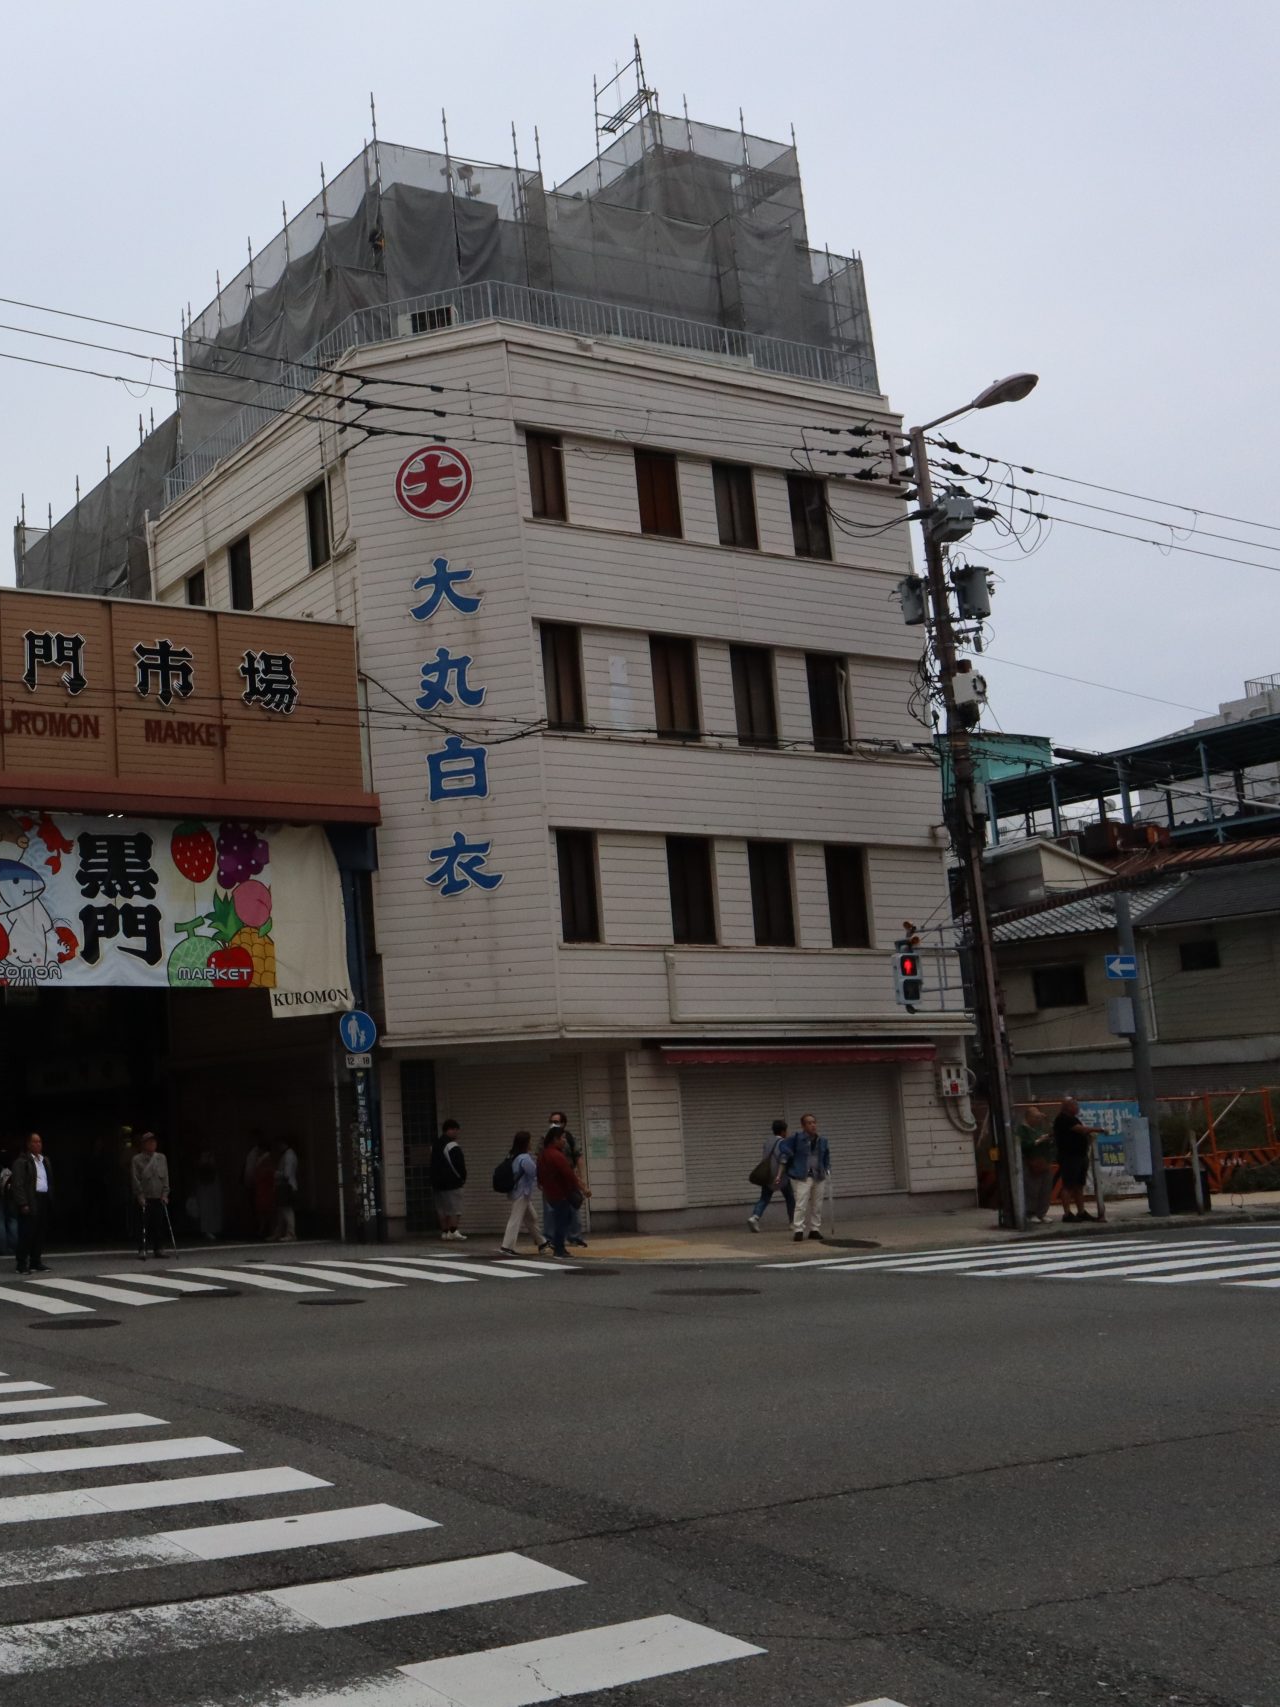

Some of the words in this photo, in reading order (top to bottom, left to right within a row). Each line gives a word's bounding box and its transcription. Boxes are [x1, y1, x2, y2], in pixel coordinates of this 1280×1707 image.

[144, 719, 231, 748] MARKET
[409, 557, 504, 896] 大丸白衣
[75, 831, 164, 967] 黒門
[177, 966, 252, 981] MARKET
[273, 988, 349, 1007] KUROMON
